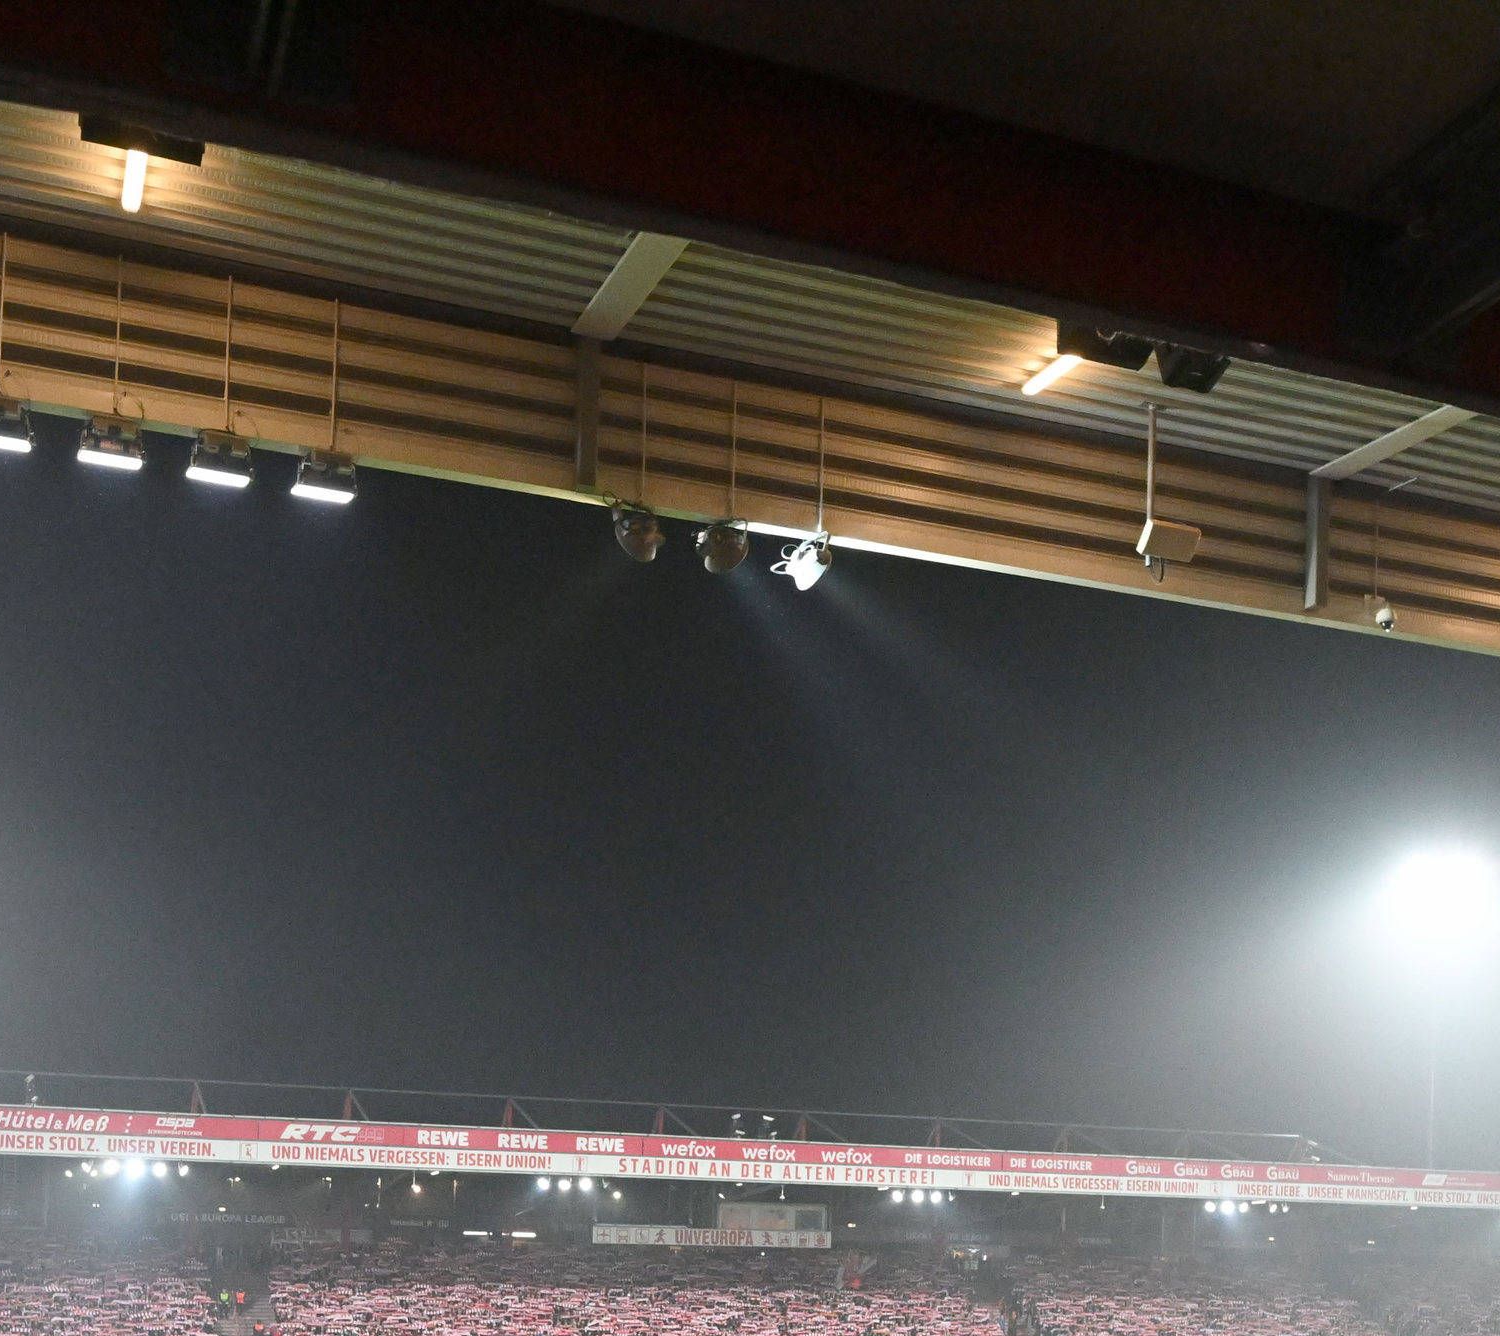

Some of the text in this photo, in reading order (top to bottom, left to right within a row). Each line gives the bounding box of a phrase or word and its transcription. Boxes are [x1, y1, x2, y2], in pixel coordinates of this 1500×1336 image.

[280, 1123, 361, 1142] RTC
[417, 1130, 469, 1147] REWE
[49, 1136, 99, 1153] STOLZ.
[107, 1138, 156, 1154] UNSER
[160, 1140, 216, 1158] VEREIN.
[497, 1133, 548, 1150] REWE
[575, 1136, 625, 1153] REWE
[272, 1145, 552, 1170] UND NIEMALS VERGESSEN: EISERN UNION!
[661, 1142, 716, 1159] wefox
[742, 1145, 796, 1163] wefox
[821, 1149, 872, 1166] wefox
[904, 1153, 992, 1168] DIE LOGISTIKER
[1010, 1157, 1093, 1172] DIE LOGISTIKER
[619, 1158, 700, 1176] STADION
[708, 1162, 731, 1177] AN
[740, 1163, 773, 1179] DER
[782, 1165, 835, 1182] ALTEN
[989, 1173, 1199, 1194] UND NIEMALS VERGESSEN: EISERN UNION!
[1307, 1186, 1344, 1200] UNSERE
